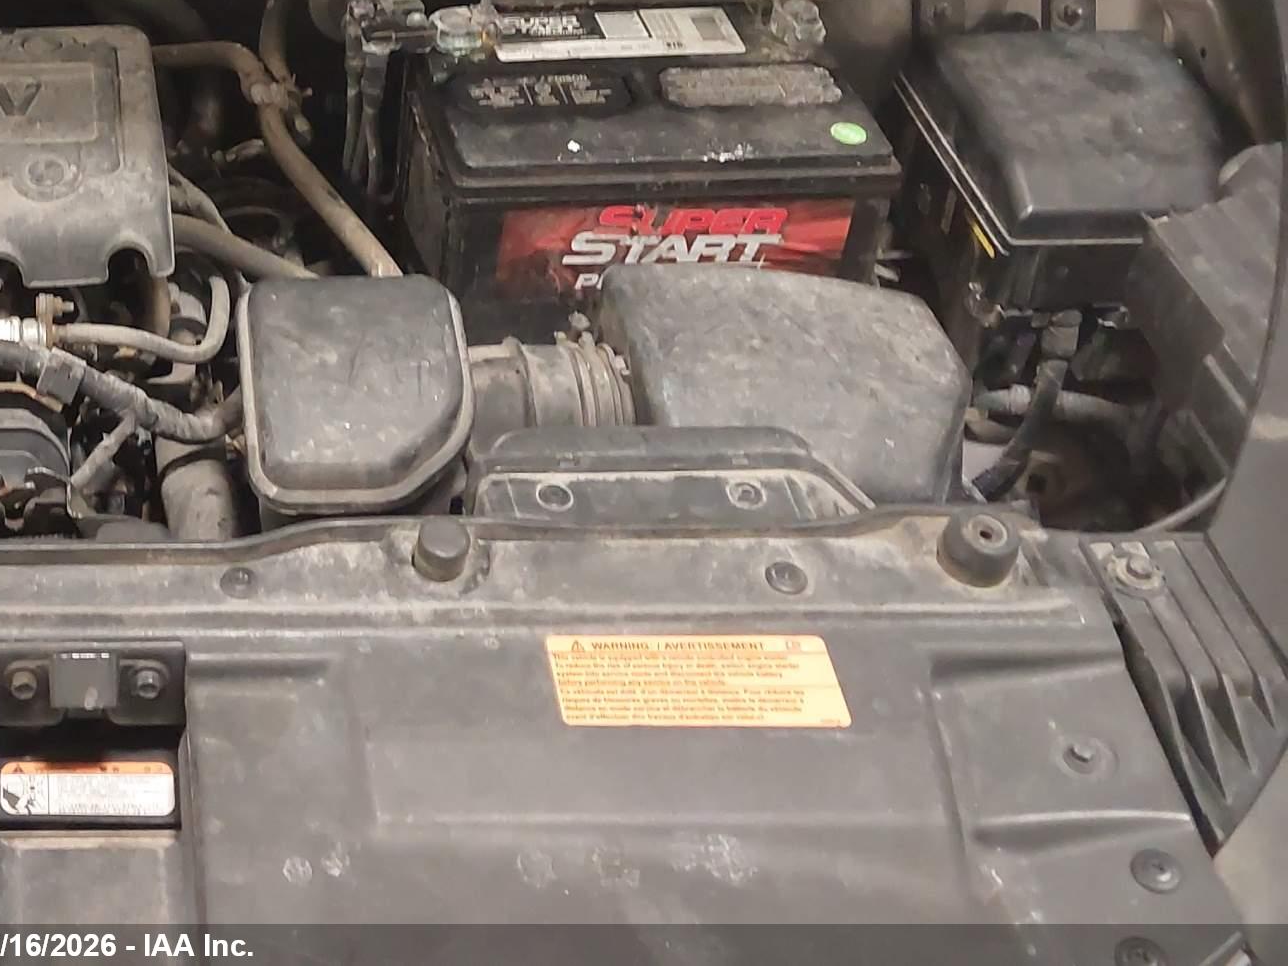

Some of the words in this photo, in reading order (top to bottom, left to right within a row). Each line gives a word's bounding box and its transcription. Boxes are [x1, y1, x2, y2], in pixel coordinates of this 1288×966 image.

[599, 205, 787, 234] SUPER
[562, 231, 781, 265] START
[591, 641, 650, 651] WARNING
[664, 641, 765, 651] AVERTISSEMENT
